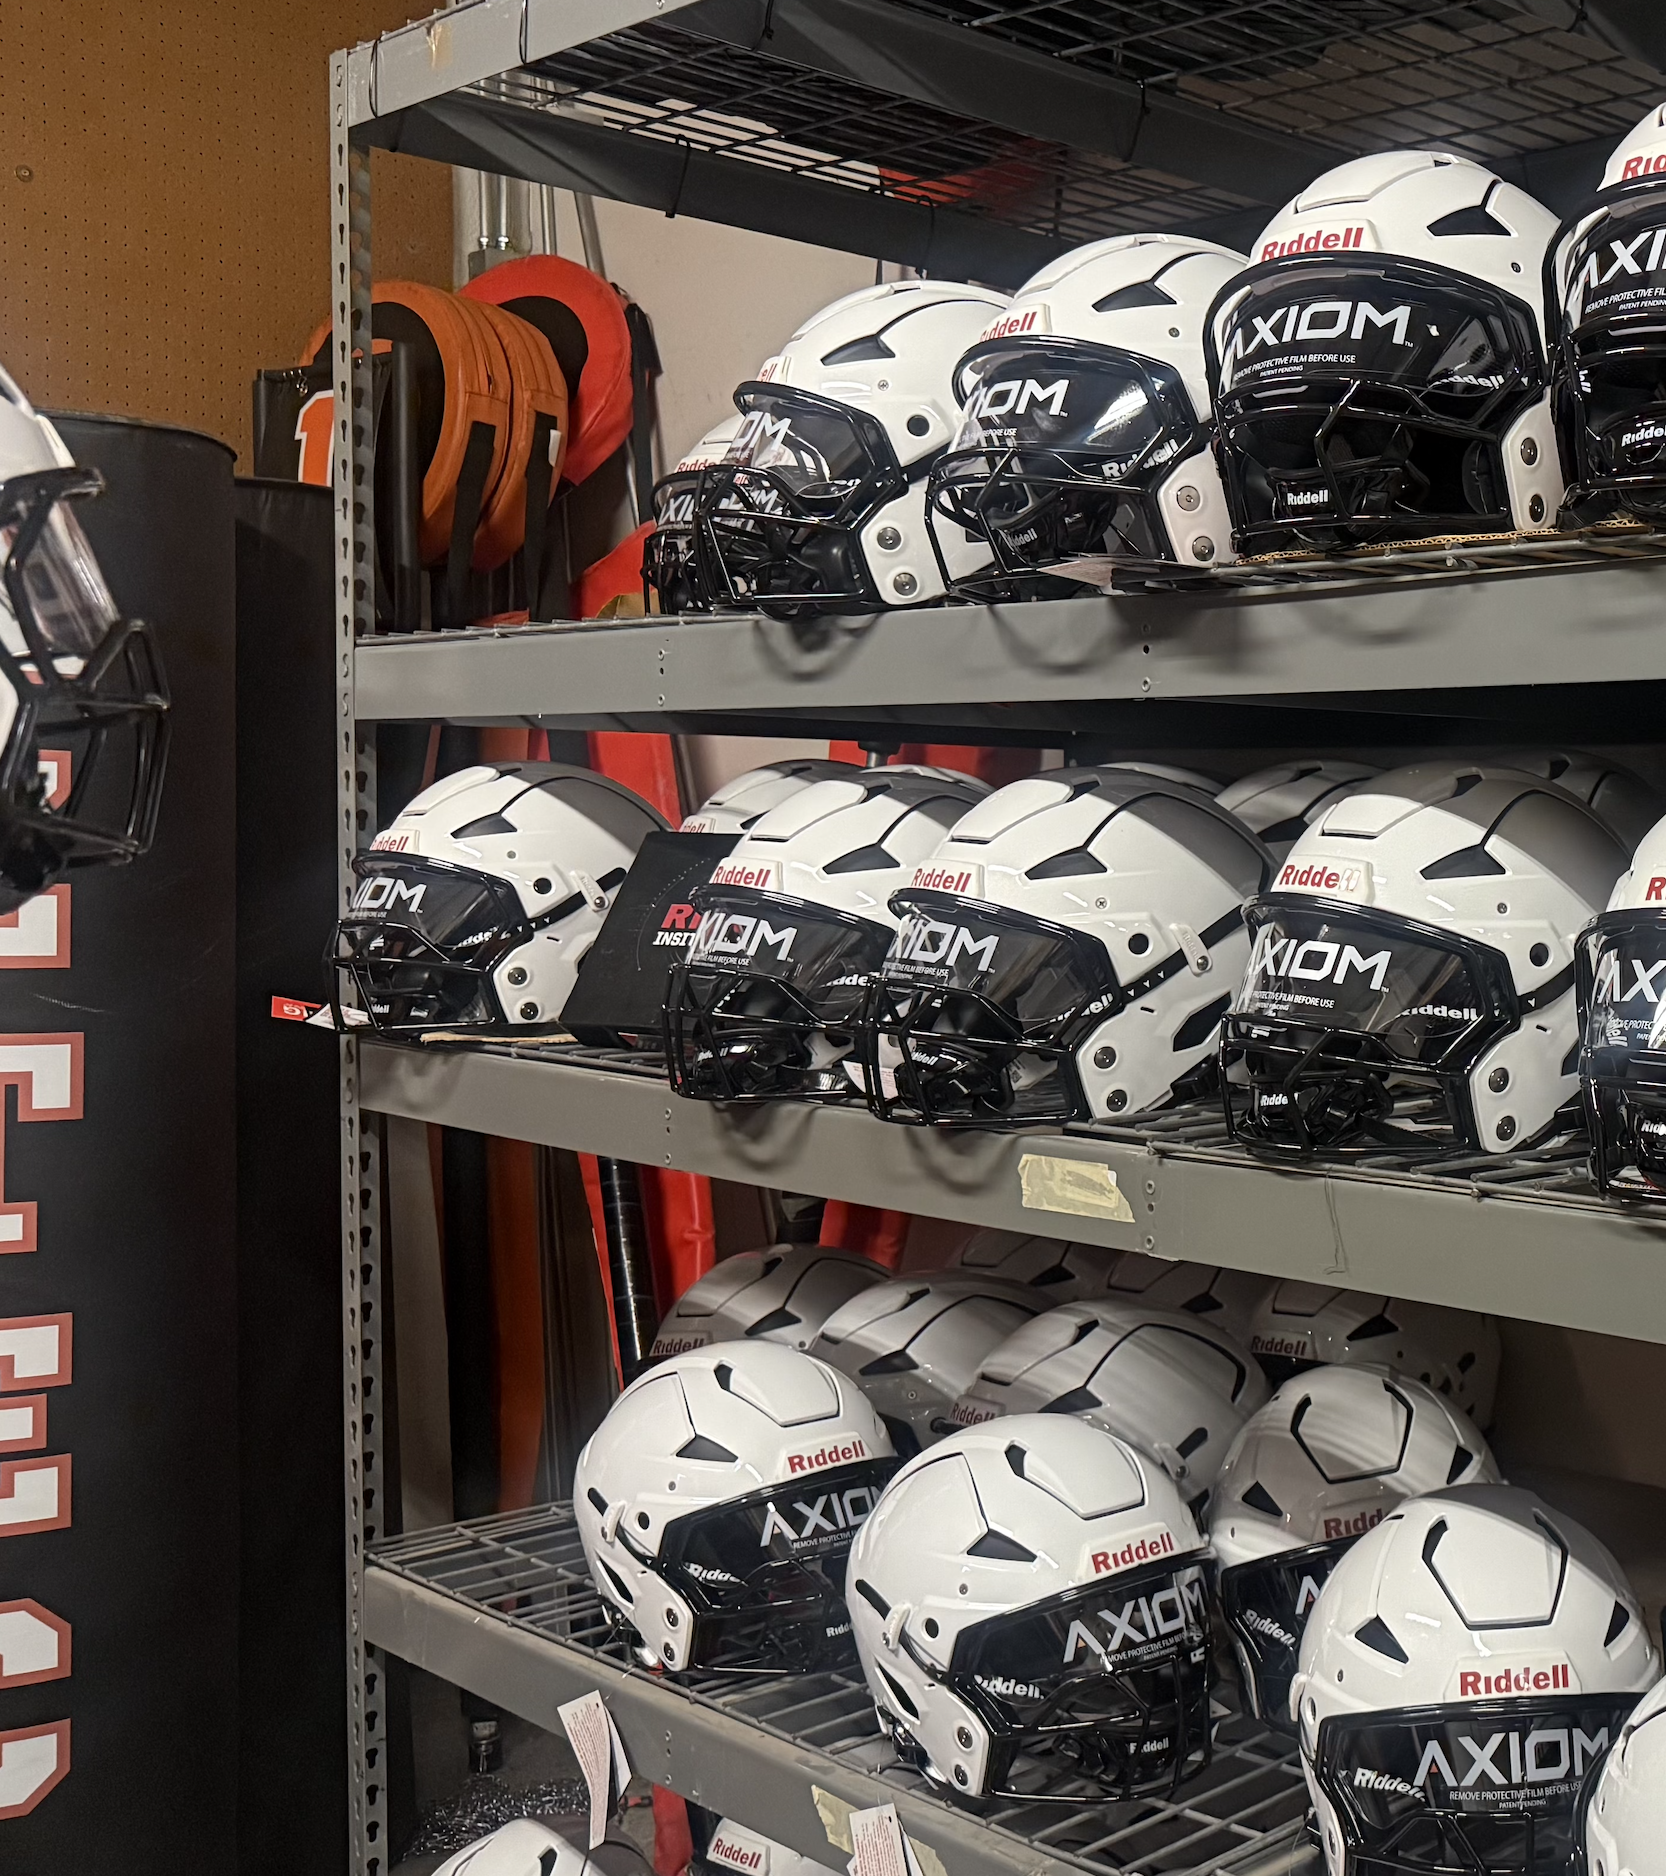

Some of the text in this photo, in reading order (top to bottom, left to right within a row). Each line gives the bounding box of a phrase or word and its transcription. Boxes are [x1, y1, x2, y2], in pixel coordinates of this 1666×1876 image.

[1261, 228, 1364, 262] Riddell
[1609, 287, 1653, 305] PROTECTIVE
[1222, 301, 1411, 363] AXIOM
[1289, 354, 1306, 365] FILM
[1308, 354, 1339, 363] BEFORE
[1339, 354, 1356, 364] USE
[972, 379, 1069, 419] IOM
[1287, 489, 1329, 506] Riddell
[713, 865, 770, 887] Riddell
[911, 868, 972, 893] Riddell
[1279, 864, 1361, 892] Riddell
[738, 958, 749, 966] USE
[936, 967, 949, 977] USE
[1252, 938, 1392, 990] XIOM
[1294, 994, 1319, 1006] BEFORE
[1320, 998, 1334, 1009] USE
[1260, 1092, 1299, 1108] Ridde
[787, 1440, 866, 1474] Riddell
[1324, 1508, 1388, 1540] Ridd
[1091, 1533, 1174, 1574] Riddell
[826, 1622, 853, 1638] Ridd
[1063, 1582, 1206, 1663] AXIOM
[1128, 1645, 1162, 1659] PROTECTIVE
[1459, 1664, 1569, 1697] Riddell
[1130, 1737, 1169, 1753] ddell
[1412, 1727, 1609, 1786] AXIOM
[1450, 1790, 1481, 1801] REMOVE
[1481, 1789, 1526, 1801] PROTECTIVE
[1527, 1787, 1544, 1799] FILM
[1544, 1784, 1571, 1797] BEFORE
[714, 1837, 762, 1869] Riddell
